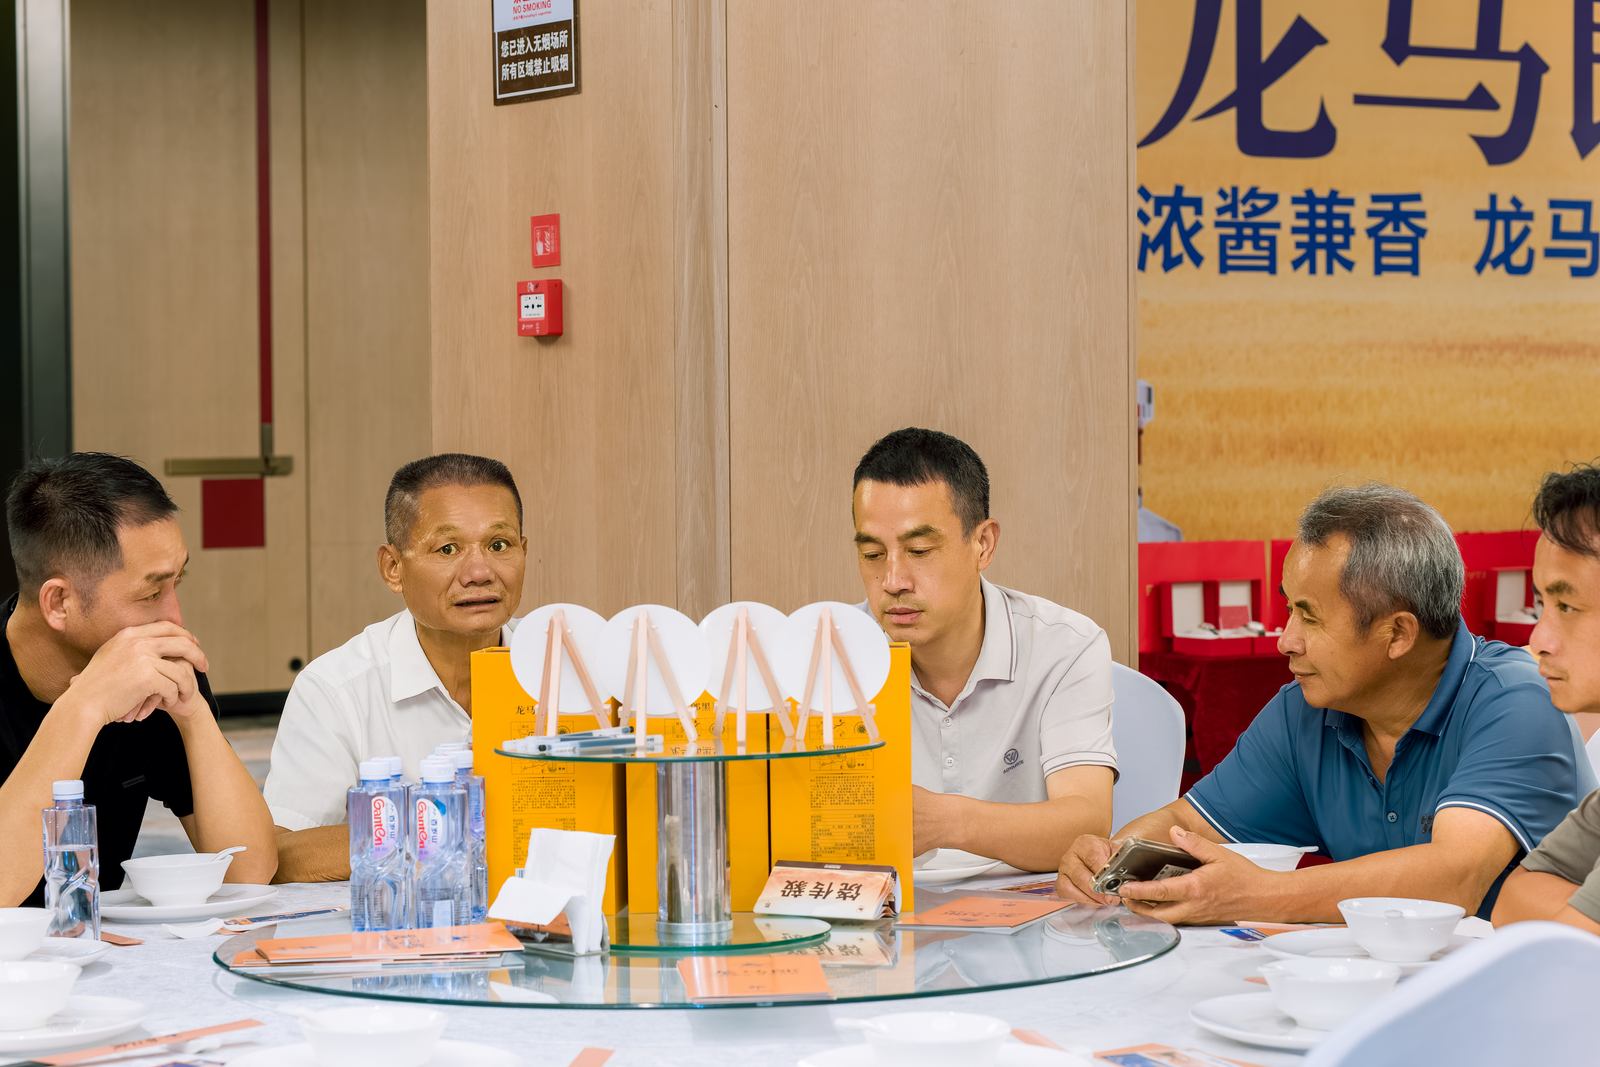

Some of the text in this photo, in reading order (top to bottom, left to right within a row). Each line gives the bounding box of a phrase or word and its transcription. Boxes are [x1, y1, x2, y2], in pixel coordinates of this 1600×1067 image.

[513, 1, 551, 14] NO SMOKING
[501, 30, 568, 58] 您已进入无烟场所
[501, 54, 568, 80] 所有区域禁止吸烟
[1137, 0, 1600, 166] 龙马
[1137, 184, 1600, 279] 浓酱兼香 龙马
